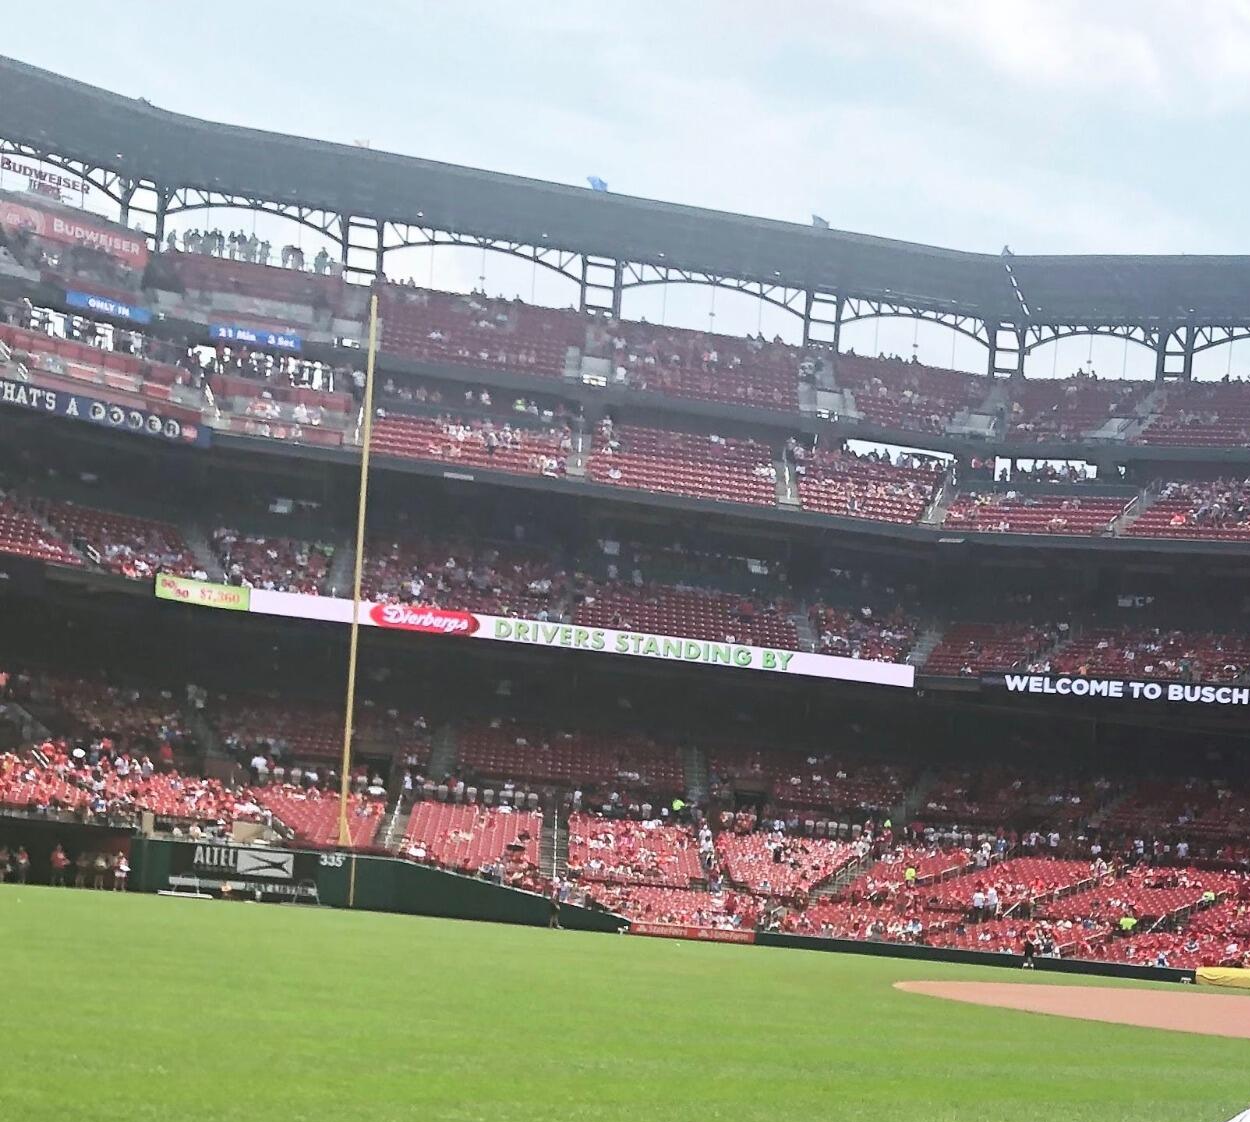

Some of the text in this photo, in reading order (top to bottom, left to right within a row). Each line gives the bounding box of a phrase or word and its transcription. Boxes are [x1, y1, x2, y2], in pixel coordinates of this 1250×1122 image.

[0, 157, 91, 195] BUDWEISER
[53, 217, 140, 255] BUDWEISER
[0, 381, 56, 411] HAT'S
[66, 398, 80, 417] A
[383, 605, 469, 632] Dierbergs
[494, 619, 794, 671] DRIVERS STANDING BY
[1004, 674, 1123, 699] WELCOME
[1129, 681, 1162, 700] TO
[1168, 684, 1249, 705] BUSCH
